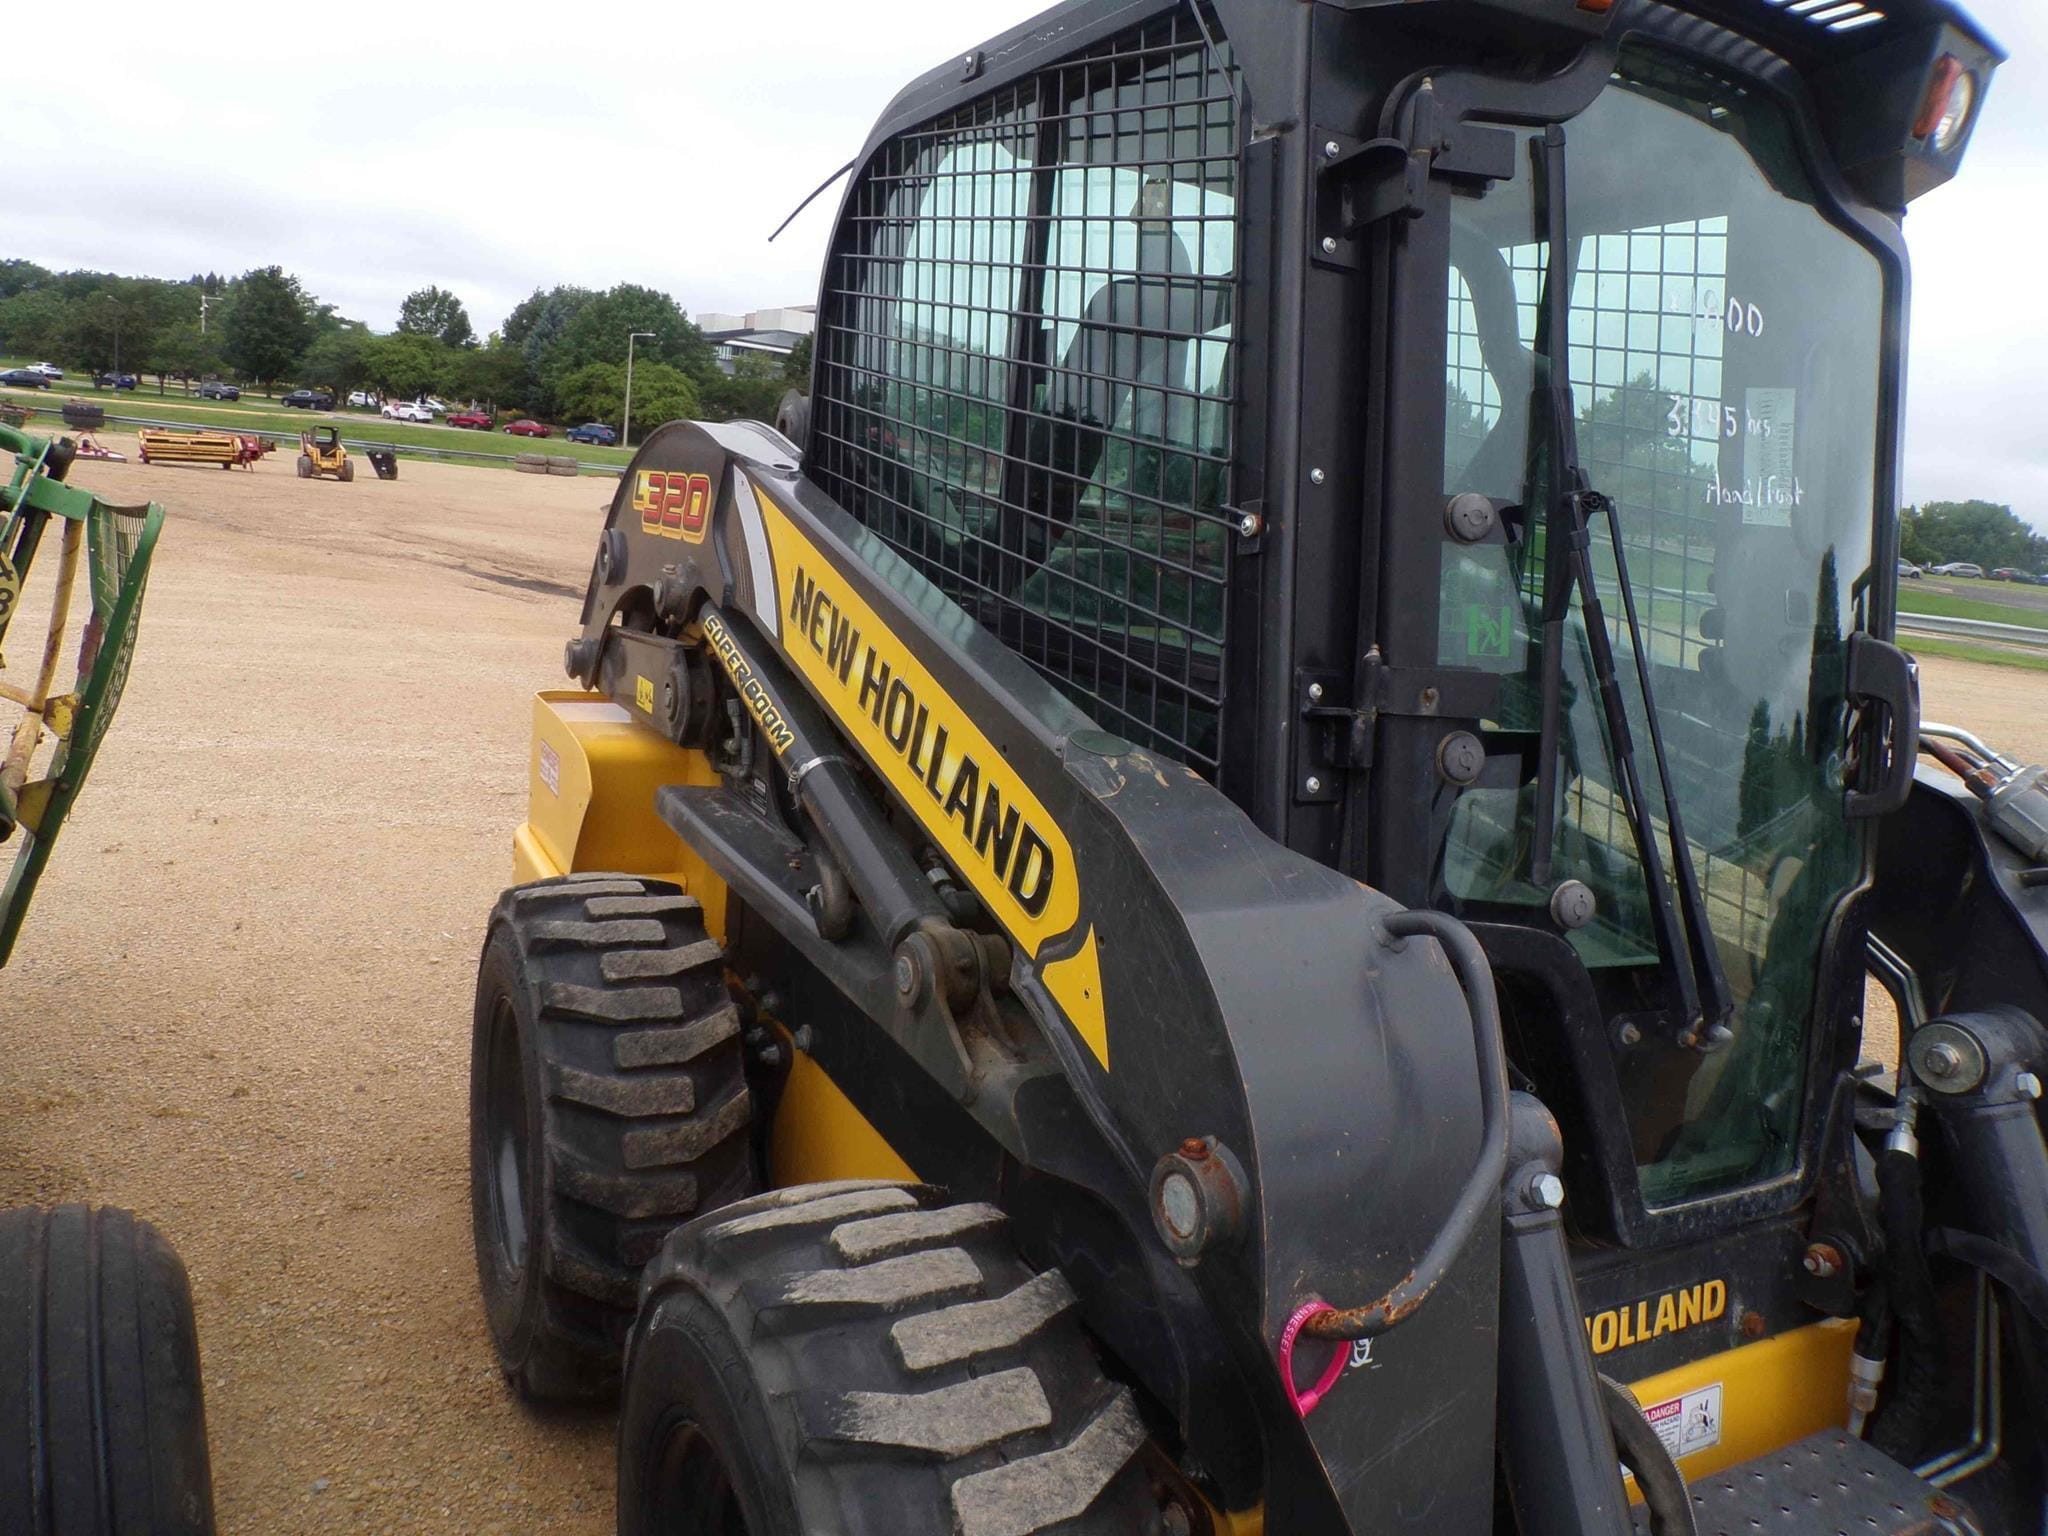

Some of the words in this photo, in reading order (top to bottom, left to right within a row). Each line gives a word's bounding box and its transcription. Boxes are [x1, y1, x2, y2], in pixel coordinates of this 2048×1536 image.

[789, 564, 860, 688] NEW
[857, 644, 1054, 919] HOLLAND
[1651, 1402, 1680, 1420] DANGER
